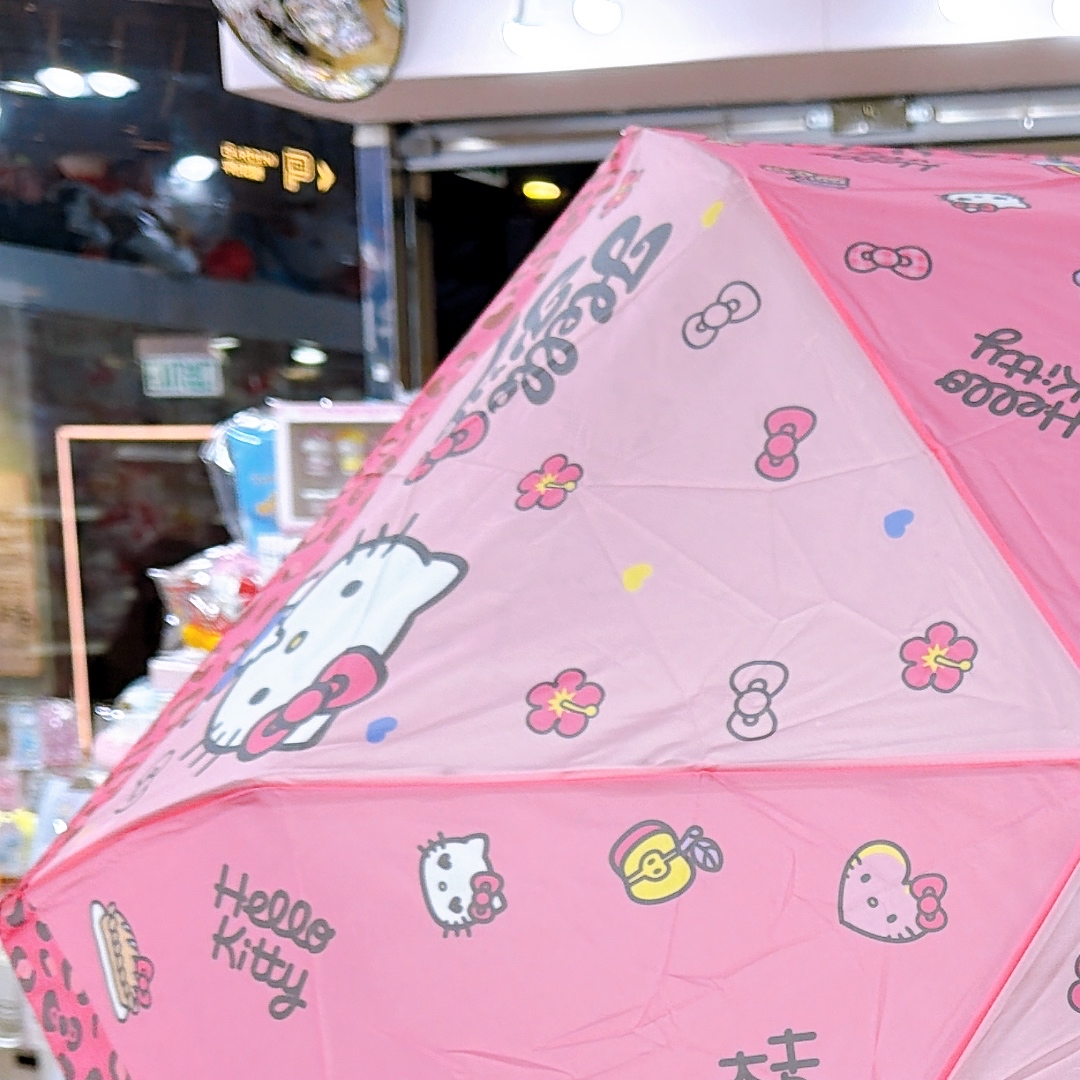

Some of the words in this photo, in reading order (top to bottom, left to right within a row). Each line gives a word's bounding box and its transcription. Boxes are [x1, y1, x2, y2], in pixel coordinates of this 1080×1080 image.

[487, 214, 673, 414] Hello
[213, 863, 337, 955] Hello
[212, 914, 310, 1021] Kitty
